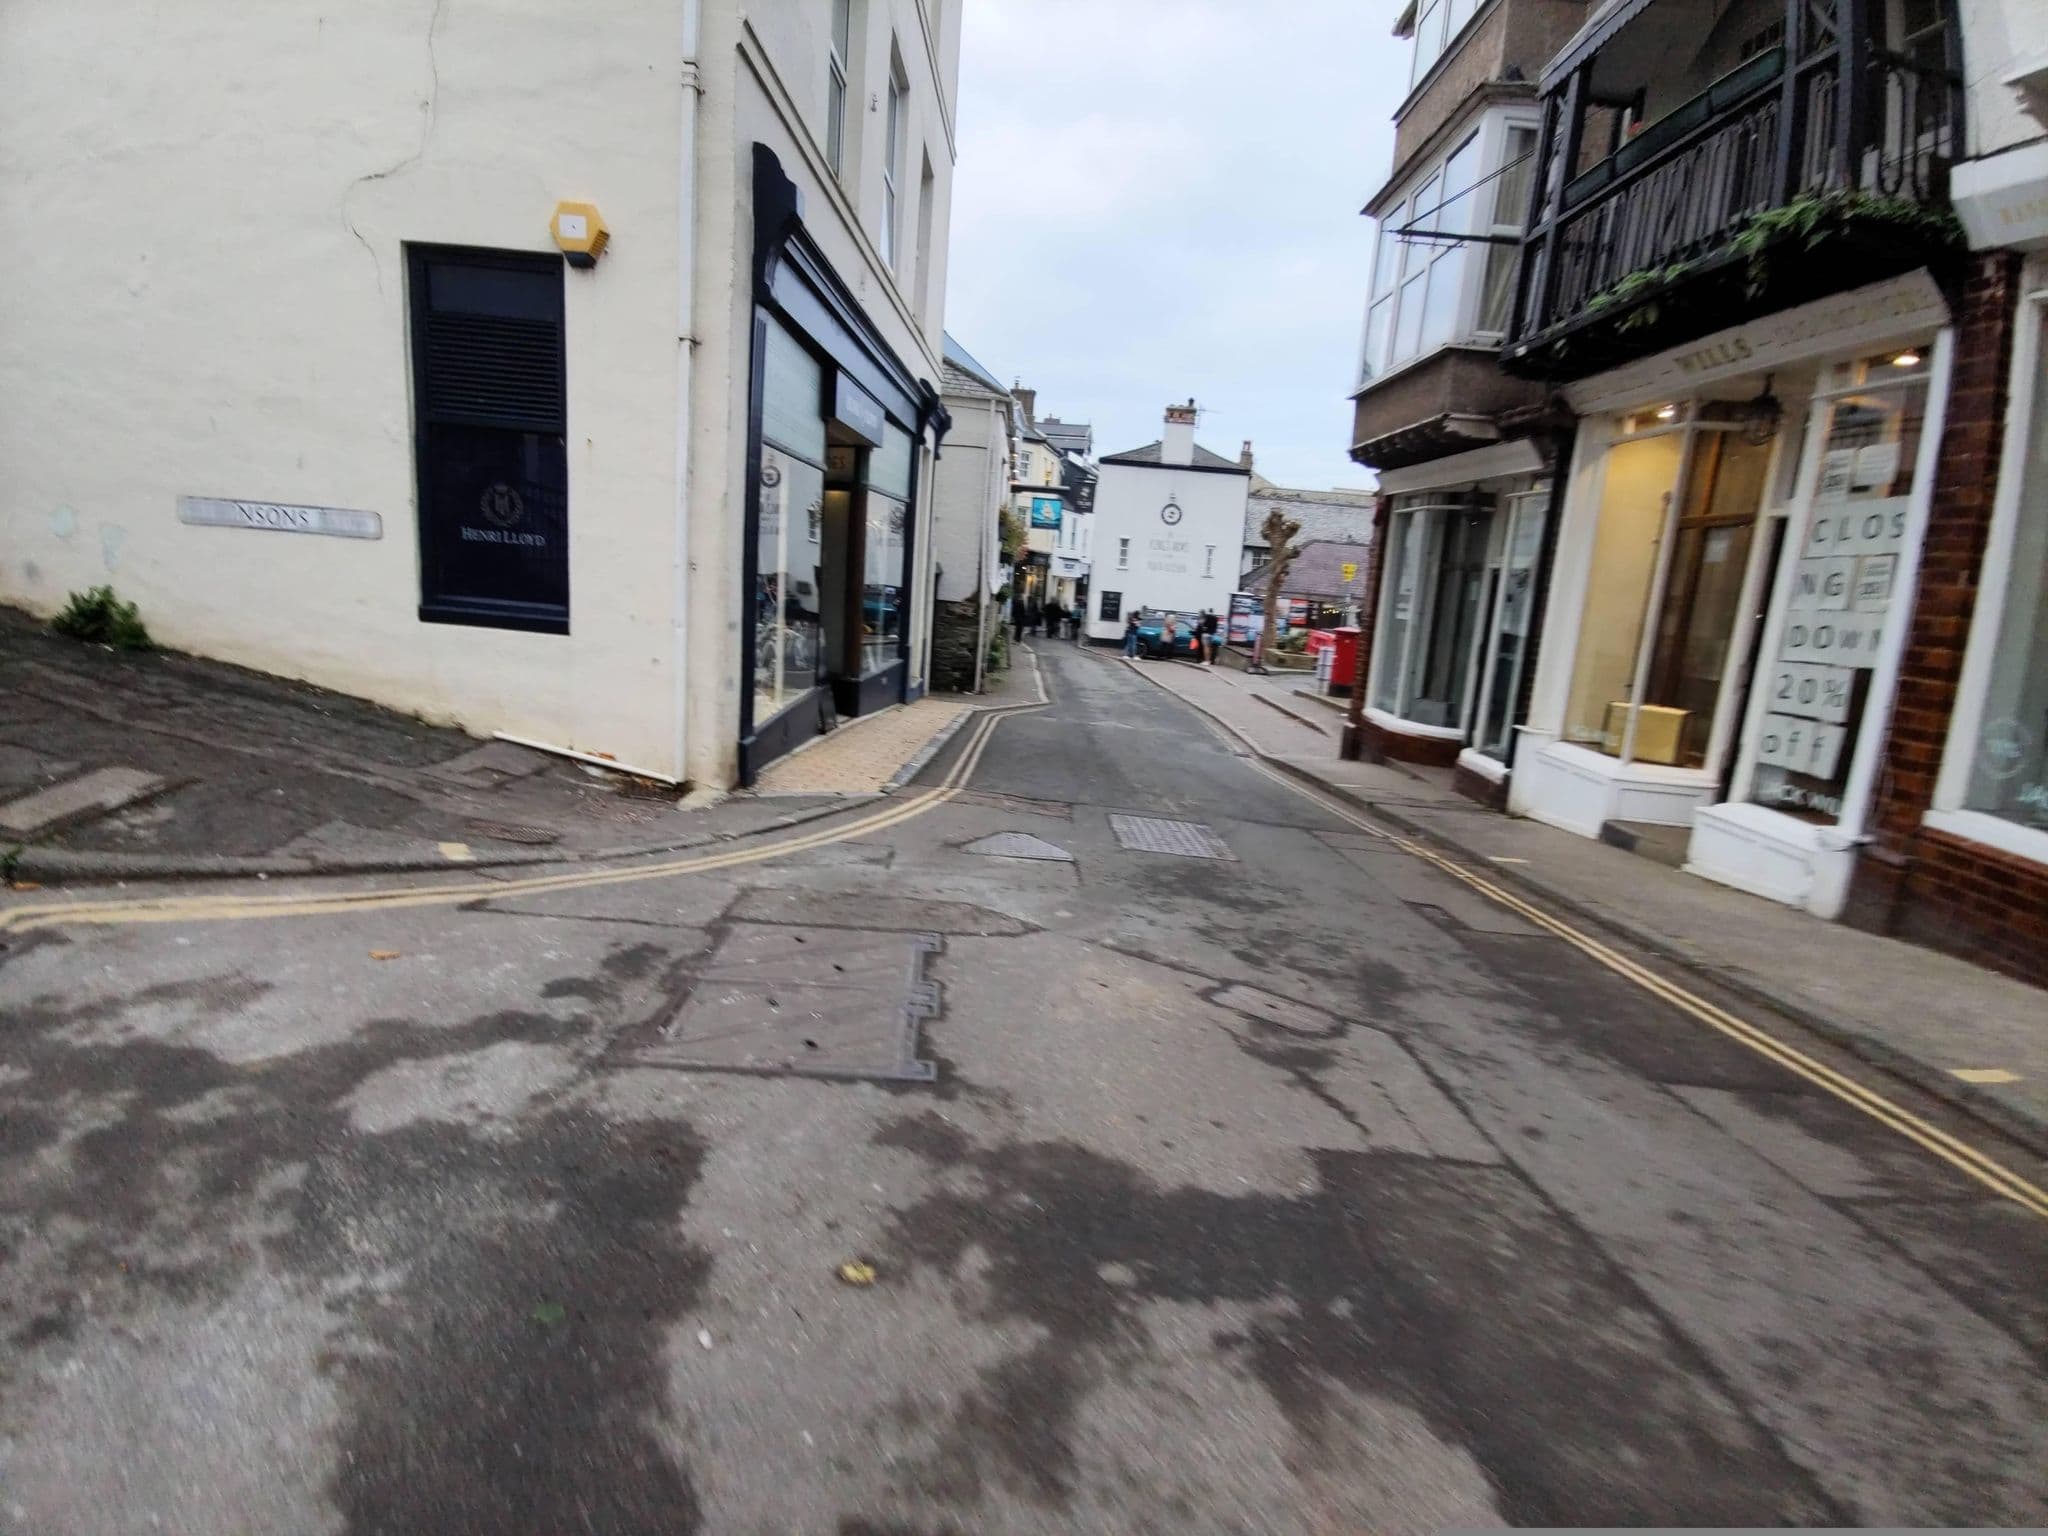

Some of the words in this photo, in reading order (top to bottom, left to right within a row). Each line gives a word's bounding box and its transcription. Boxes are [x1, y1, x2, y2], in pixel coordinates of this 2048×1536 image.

[1674, 337, 1752, 374] WILLS
[461, 527, 501, 543] HENRI
[503, 530, 546, 546] LLOYD
[1776, 674, 1848, 708] 20%
